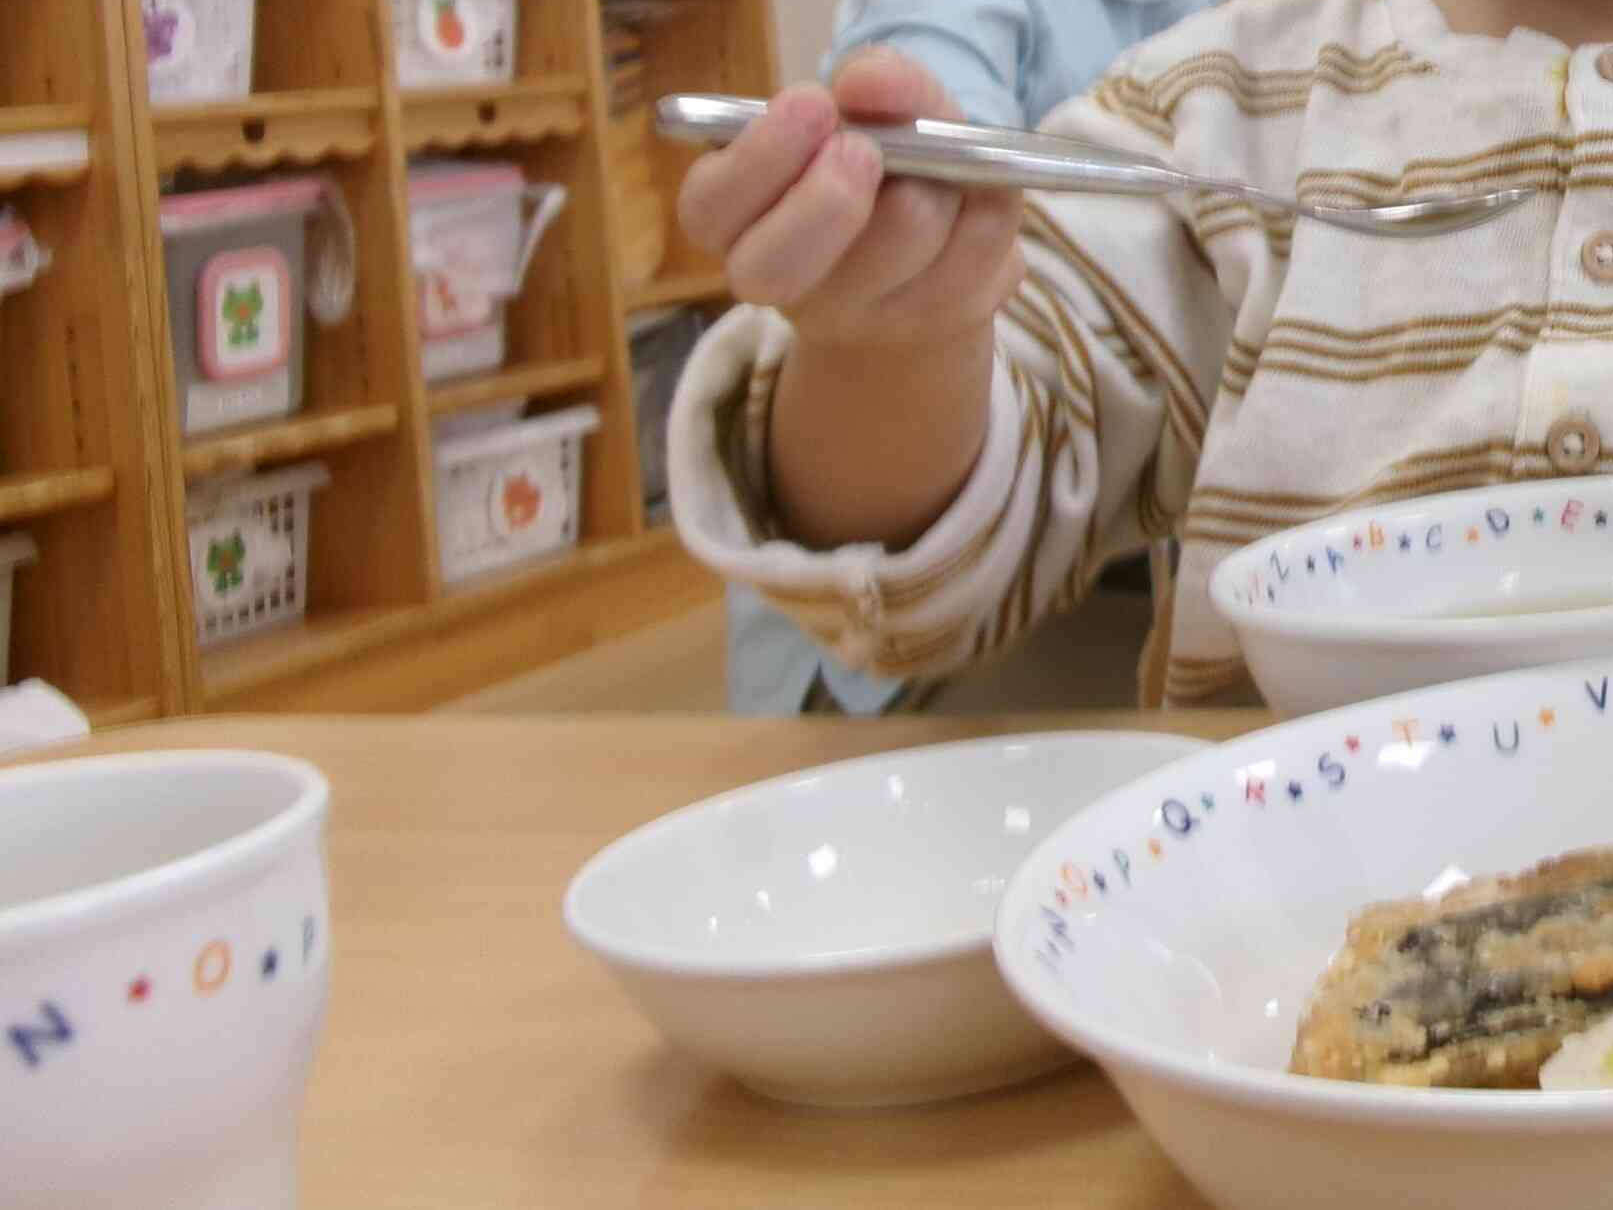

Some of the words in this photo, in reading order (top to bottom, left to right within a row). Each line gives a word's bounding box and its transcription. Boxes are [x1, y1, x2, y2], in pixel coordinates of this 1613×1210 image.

[1426, 524, 1443, 551] C
[1486, 508, 1510, 534] D
[1161, 797, 1198, 837] Q
[1317, 751, 1346, 791] S
[1492, 719, 1520, 757] U
[1583, 676, 1608, 711] V
[7, 1000, 73, 1069] N
[192, 939, 232, 997] O
